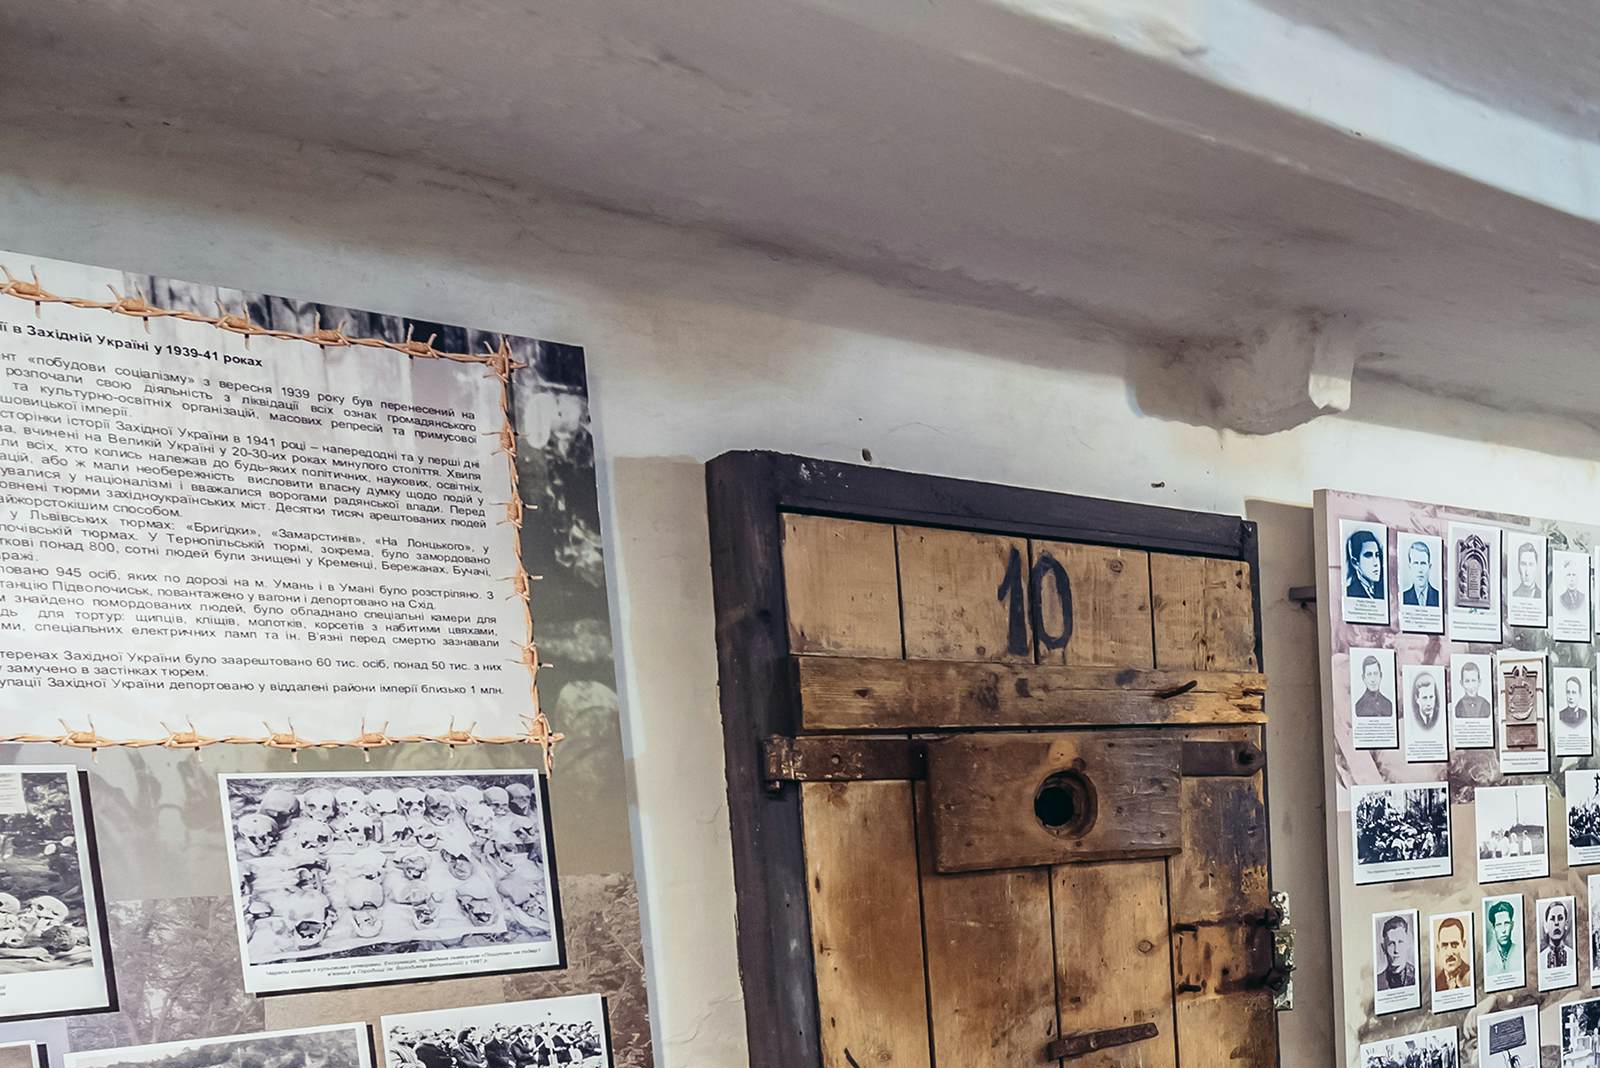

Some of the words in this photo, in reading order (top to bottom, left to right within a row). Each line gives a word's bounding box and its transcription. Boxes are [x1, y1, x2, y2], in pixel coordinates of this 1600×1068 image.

[13, 327, 21, 336] в
[27, 325, 92, 344] Західній
[96, 333, 149, 351] Україні
[154, 343, 162, 355] у
[166, 342, 219, 361] 1939-41
[223, 353, 263, 368] роках
[5, 367, 83, 384] розпочали
[96, 378, 132, 390] свою
[310, 402, 334, 415] всіх
[343, 408, 378, 421] ознак
[13, 382, 28, 392] та
[270, 412, 322, 427] масових
[331, 419, 383, 434] репресій
[393, 427, 405, 436] та
[203, 377, 210, 386] з
[219, 379, 273, 394] вересня
[282, 384, 311, 399] 1939
[317, 392, 345, 406] року
[352, 393, 373, 409] був
[461, 410, 476, 421] на
[23, 426, 79, 440] вчинені
[85, 432, 102, 442] на
[108, 432, 162, 448] Великій
[167, 438, 215, 454] Україні
[231, 444, 287, 461] 20-30-их
[291, 453, 327, 465] роках
[332, 458, 388, 472] минулого
[446, 467, 482, 481] Хвиля
[67, 414, 110, 431] історії
[115, 419, 173, 436] Західної
[177, 425, 229, 442] України
[246, 432, 276, 447] 1941
[281, 439, 307, 451] році
[401, 453, 415, 463] та
[428, 456, 461, 469] перші
[463, 459, 480, 471] дні
[64, 444, 89, 455] хто
[94, 447, 143, 460] колись
[148, 453, 208, 467] належав
[212, 459, 227, 470] до
[234, 458, 297, 476] будь-яких
[41, 453, 68, 466] або
[93, 460, 130, 472] мали
[247, 475, 314, 490] висловити
[319, 482, 361, 496] власну
[366, 486, 401, 500] думку
[406, 490, 438, 502] щодо
[443, 492, 473, 504] подій
[53, 484, 101, 497] тюрми
[275, 500, 326, 516] Десятки
[331, 508, 365, 519] тисяч
[450, 518, 488, 530] людей
[190, 483, 262, 497] вважалися
[269, 490, 328, 503] ворогами
[450, 503, 486, 520] Перед
[39, 540, 85, 552] понад
[124, 544, 159, 555] сотні
[165, 547, 209, 559] людей
[213, 548, 246, 562] були
[250, 553, 301, 565] знищені
[381, 547, 410, 561] було
[55, 565, 82, 578] 945
[126, 572, 158, 582] яких
[163, 574, 181, 583] по
[185, 574, 229, 587] дорозі
[233, 578, 250, 587] на
[273, 577, 314, 591] Умань
[340, 581, 375, 594] Умані
[379, 583, 407, 597] було
[14, 592, 85, 606] знайдено
[253, 603, 284, 617] було
[290, 605, 358, 619] обладнано
[430, 613, 471, 625] камери
[476, 615, 497, 625] для
[258, 593, 300, 603] вагони
[391, 599, 406, 609] на
[997, 546, 1073, 656] 10
[37, 609, 65, 620] для
[314, 619, 364, 632] корсетів
[385, 621, 441, 634] набитими
[223, 630, 257, 639] ламп
[264, 631, 279, 640] та
[349, 634, 386, 646] перед
[392, 636, 436, 647] смертю
[442, 638, 500, 648] зазнавали
[6, 664, 78, 676] замучено
[93, 664, 157, 676] застінках
[63, 649, 123, 663] Західної
[129, 651, 181, 665] України
[184, 652, 217, 666] було
[316, 656, 332, 667] 60
[393, 660, 429, 671] понад
[431, 658, 446, 670] 50
[482, 662, 503, 671] них
[47, 676, 107, 690] Західної
[112, 677, 165, 691] України
[269, 680, 329, 693] віддалені
[333, 681, 376, 694] райони
[379, 682, 418, 696] імперії
[421, 682, 467, 695] близько
